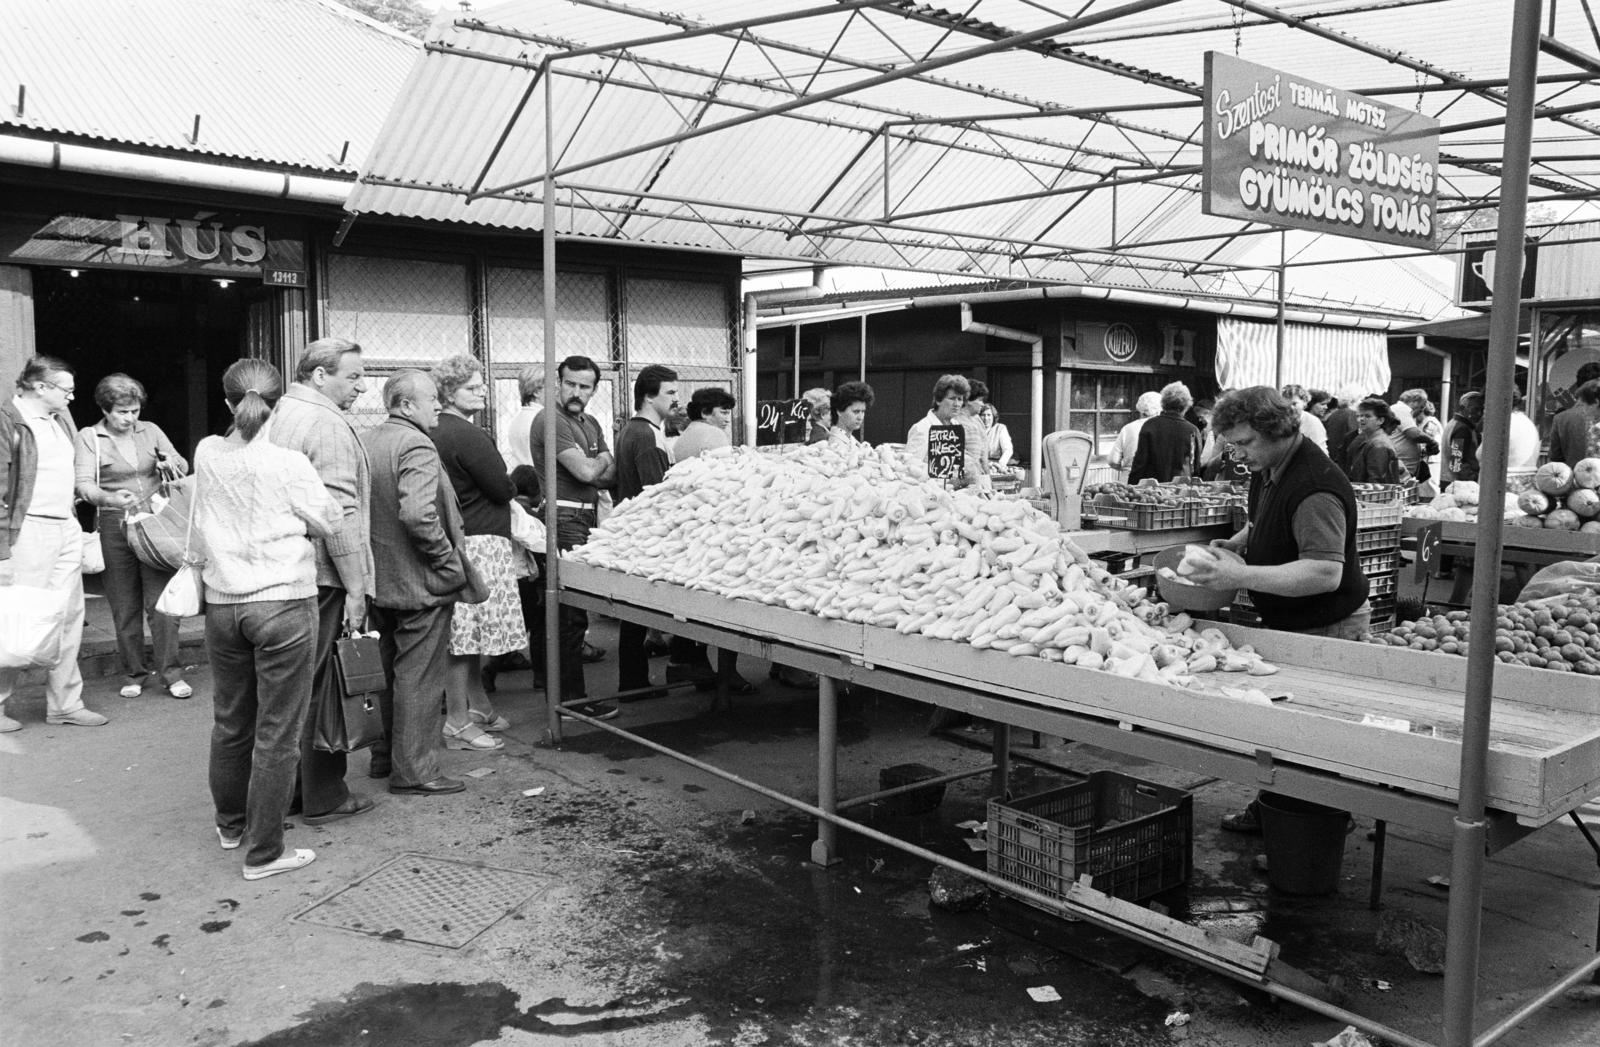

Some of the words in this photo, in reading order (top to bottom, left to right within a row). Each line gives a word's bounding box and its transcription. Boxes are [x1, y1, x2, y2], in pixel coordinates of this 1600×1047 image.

[1216, 74, 1281, 139] Szentesi
[1289, 82, 1340, 116] TERMÁL
[1346, 99, 1386, 128] MGTSZ
[1249, 120, 1340, 173] PRIMŐR
[1349, 141, 1433, 194] ZÖLDSÉG
[1239, 166, 1364, 225] GYÜMÖLCS
[1371, 195, 1431, 236] TOJÁS
[116, 212, 267, 263] HÚS
[272, 271, 297, 284] 13113
[930, 430, 959, 442] EXTRA
